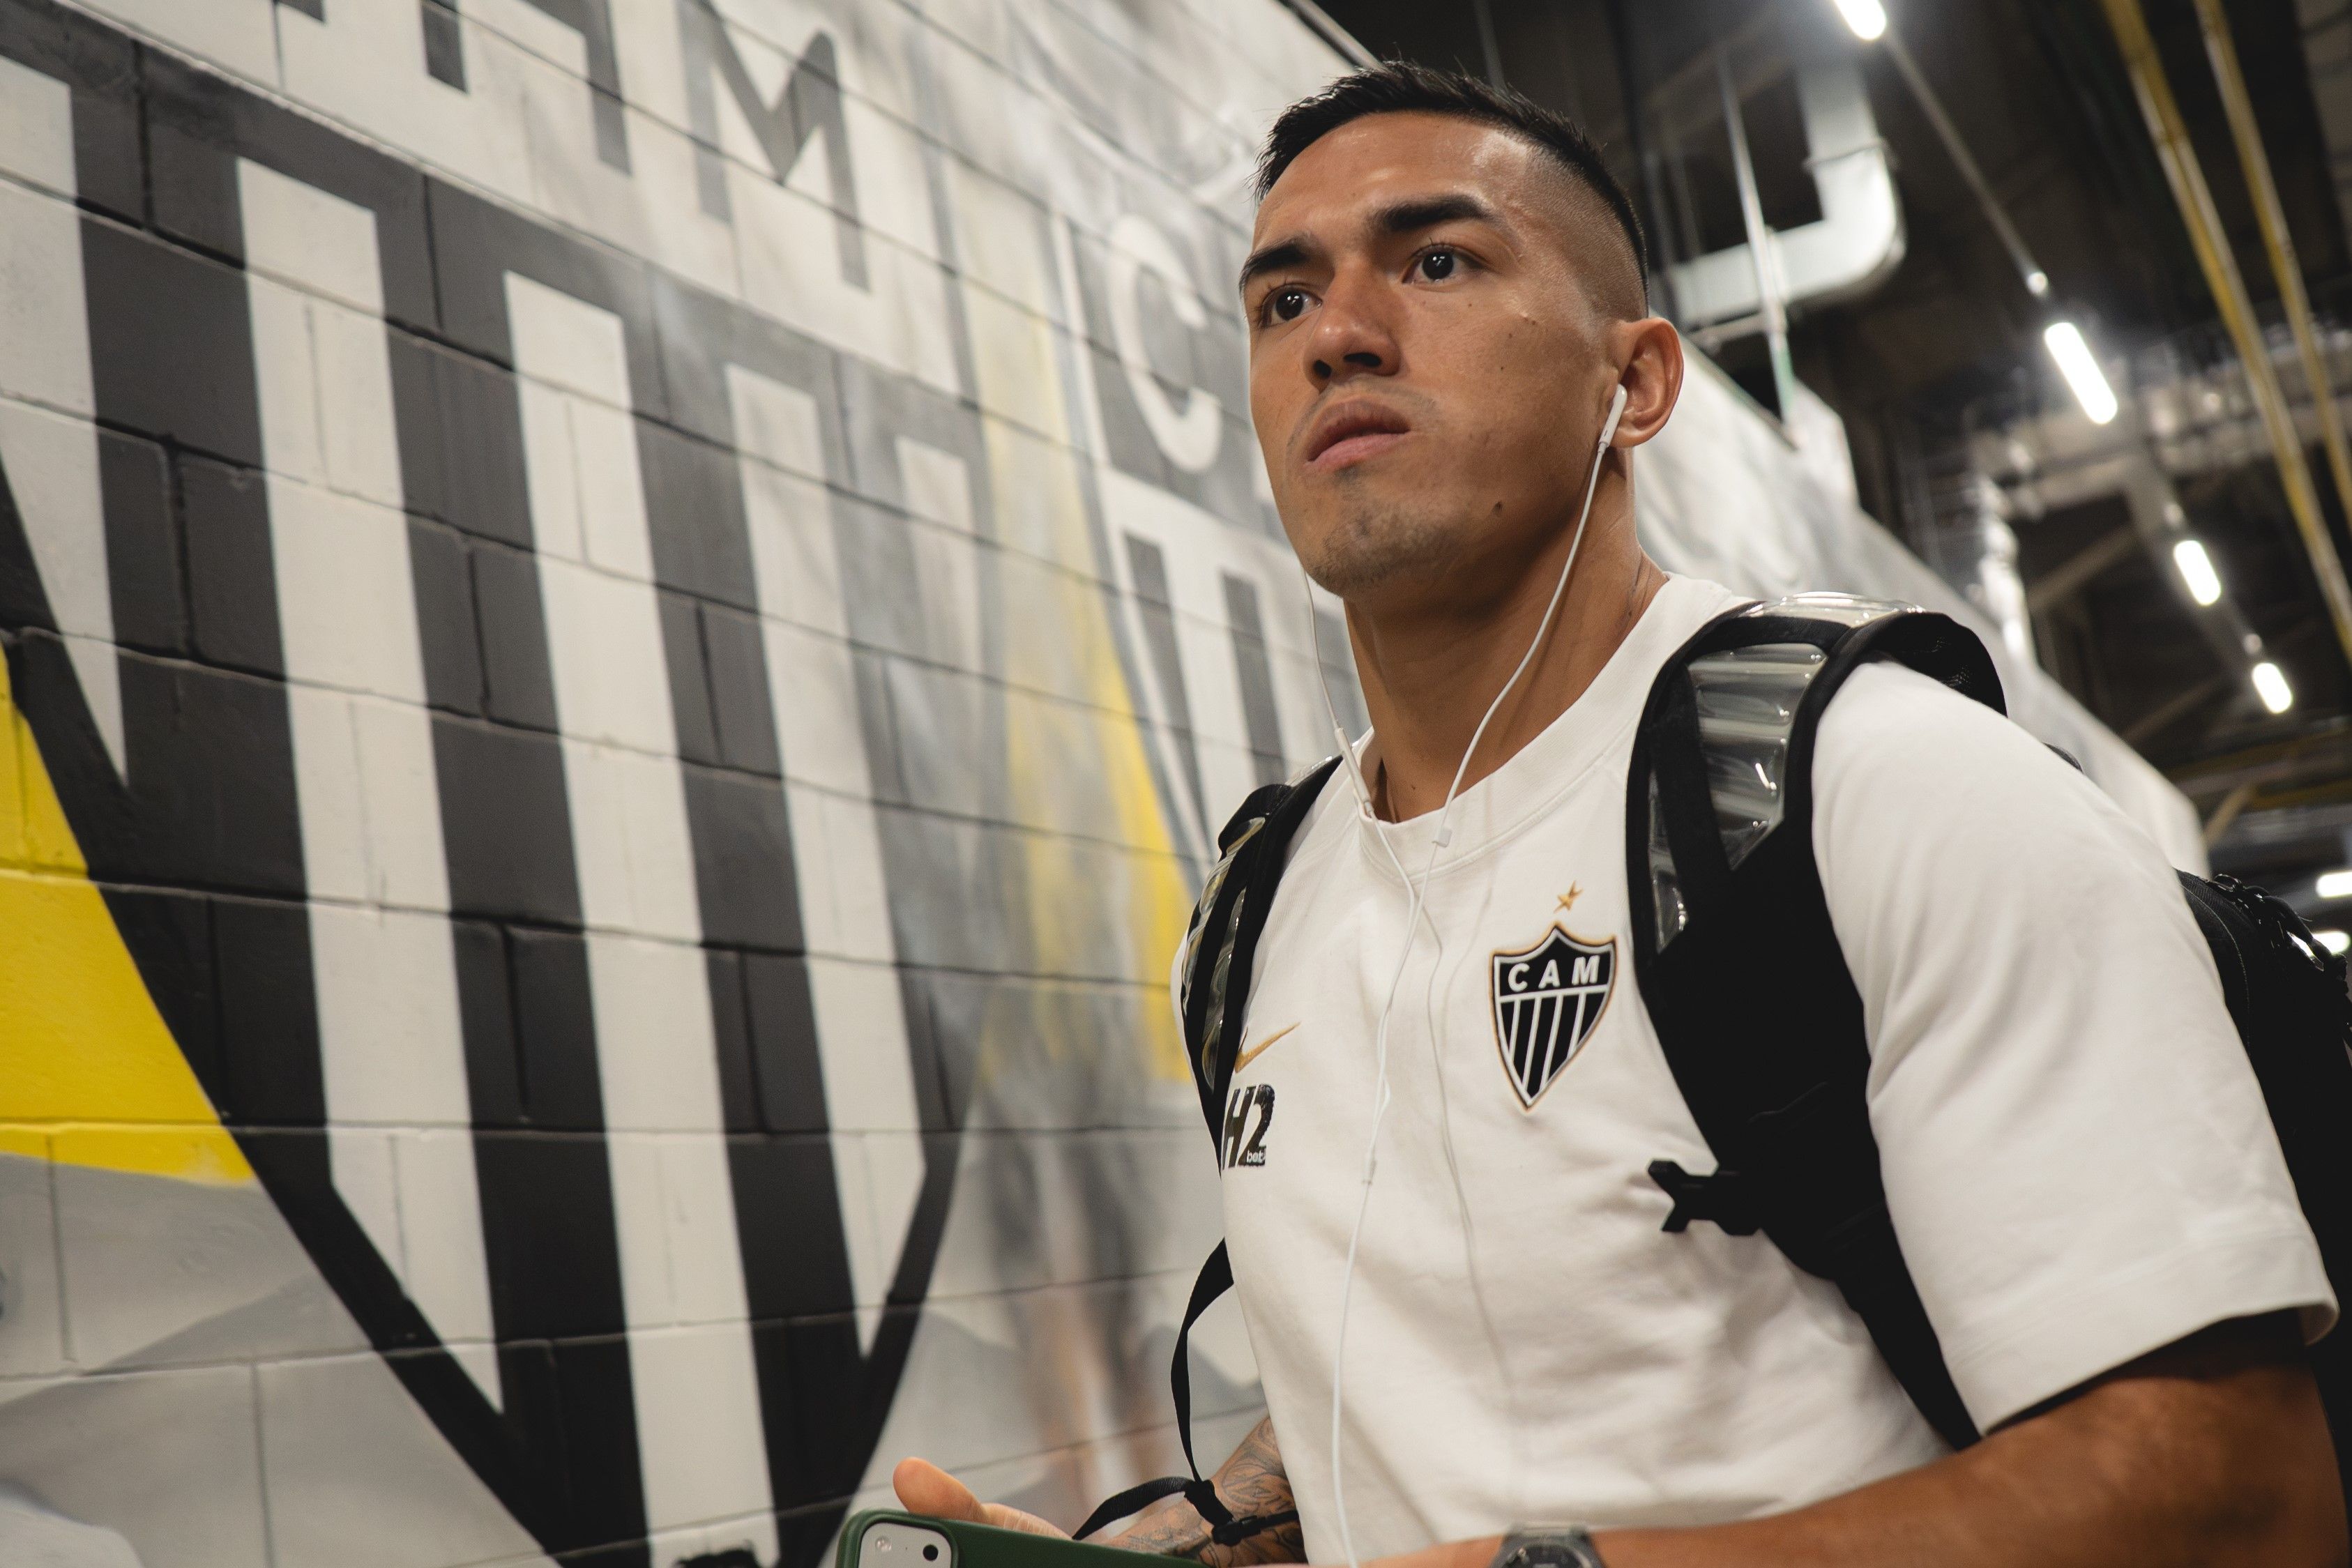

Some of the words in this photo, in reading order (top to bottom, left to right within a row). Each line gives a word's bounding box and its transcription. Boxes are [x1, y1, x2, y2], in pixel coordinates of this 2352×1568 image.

[1107, 215, 1275, 501] C
[1508, 955, 1600, 992] CAM
[1222, 1084, 1275, 1170] H2
